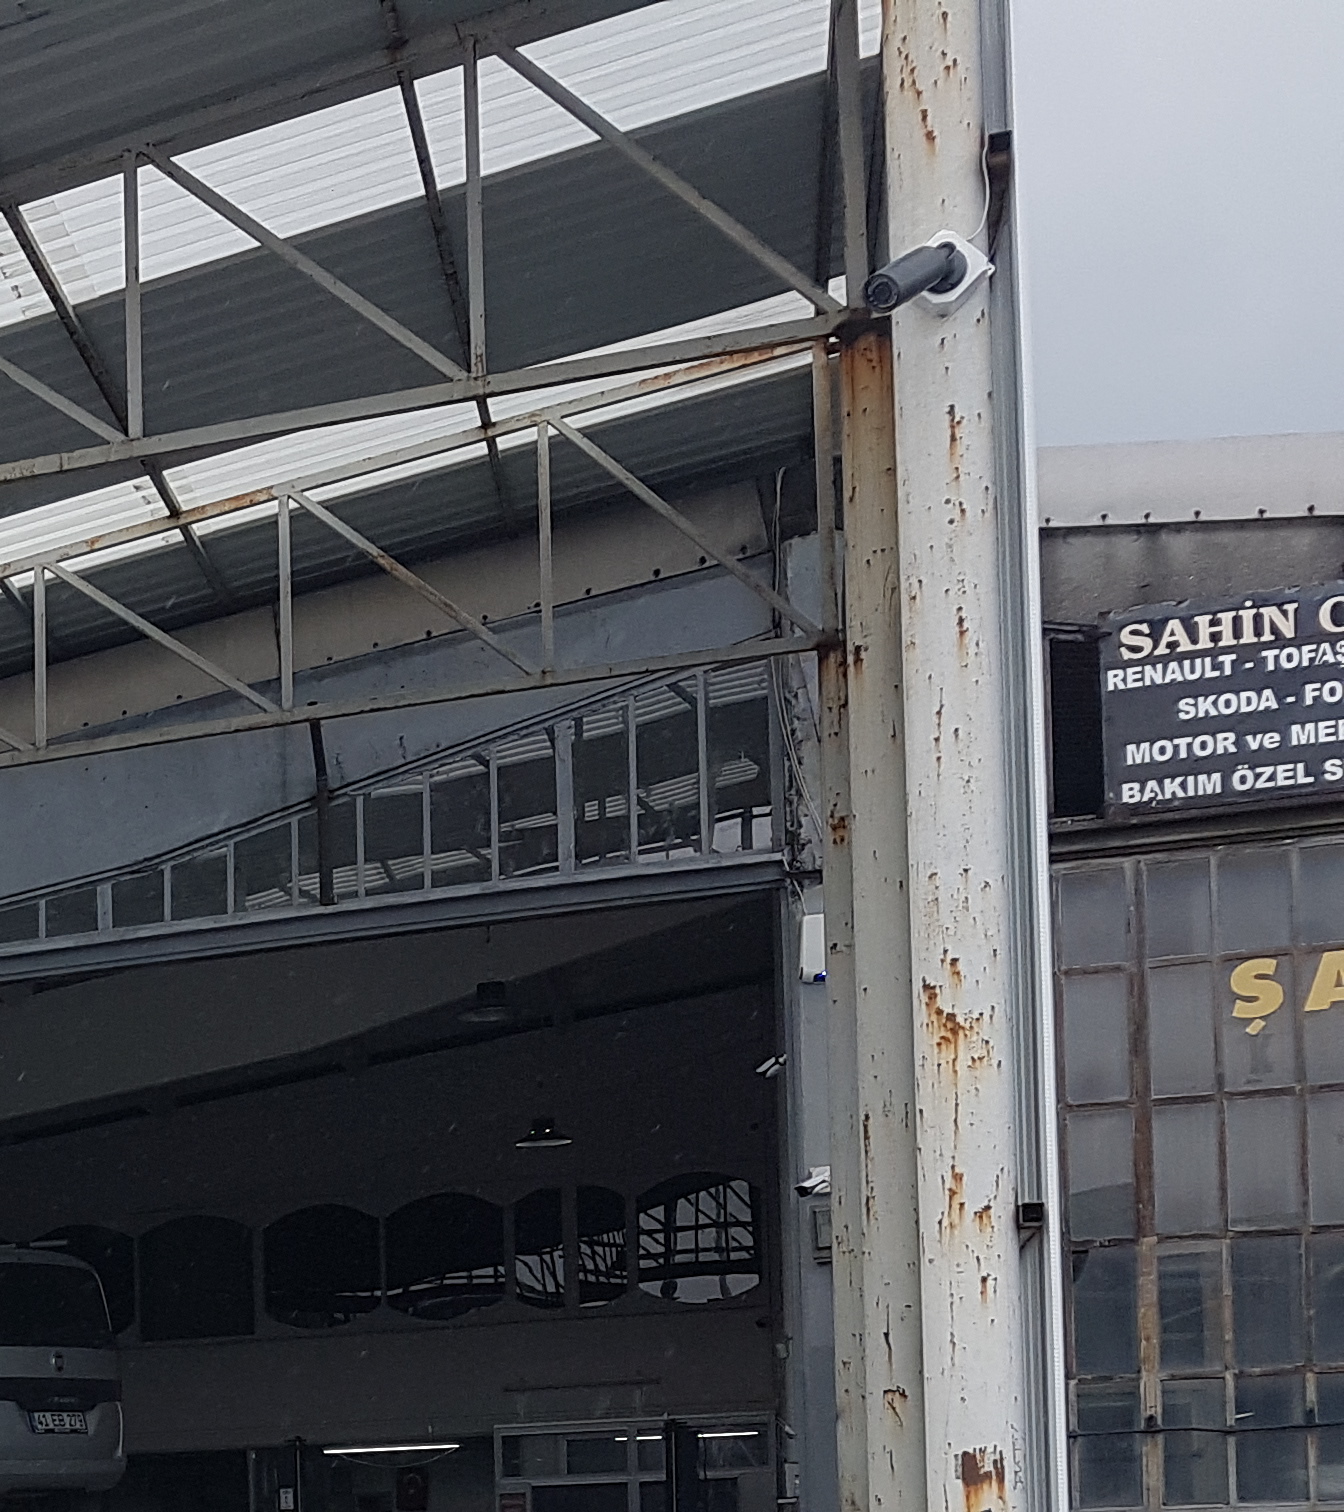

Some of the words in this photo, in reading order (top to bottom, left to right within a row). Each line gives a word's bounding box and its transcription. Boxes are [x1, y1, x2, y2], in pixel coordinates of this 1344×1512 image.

[1106, 654, 1237, 691] RENAULT
[1177, 688, 1280, 720] SKODA
[1126, 732, 1237, 766] MOTOR
[1244, 731, 1281, 751] ve
[1121, 772, 1222, 804] BAKIM
[1232, 763, 1315, 791] ÖZEL
